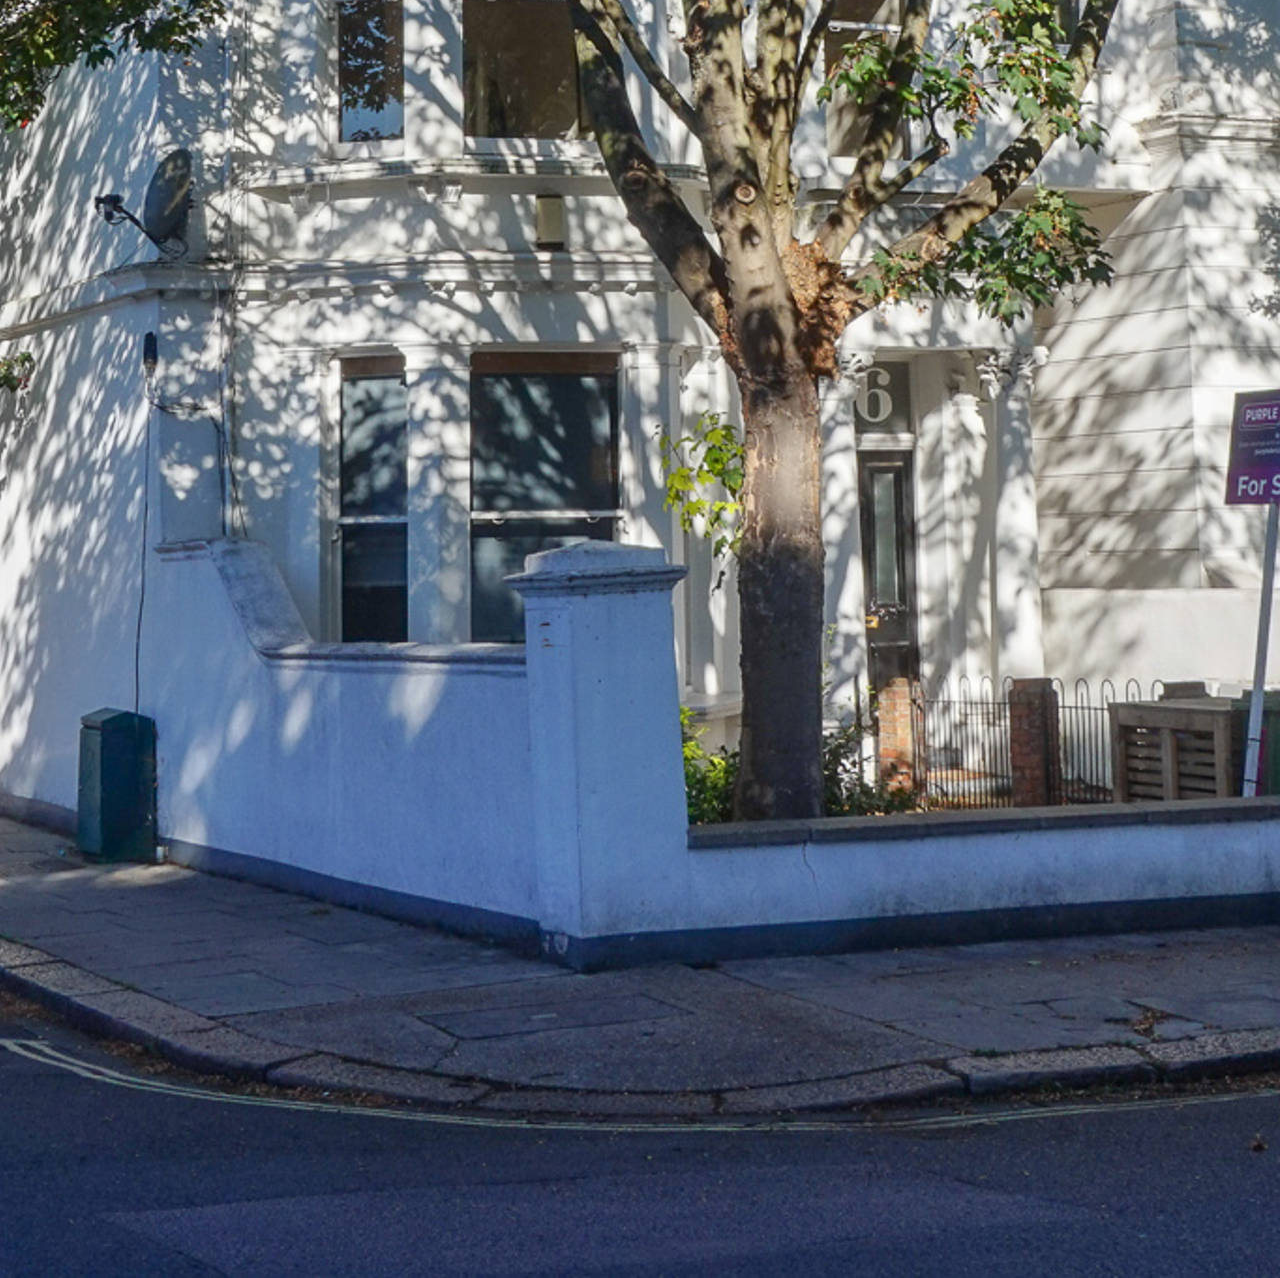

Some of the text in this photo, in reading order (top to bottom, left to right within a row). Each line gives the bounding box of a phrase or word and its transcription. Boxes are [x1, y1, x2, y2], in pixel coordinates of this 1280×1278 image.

[855, 367, 893, 423] 6
[1245, 406, 1279, 422] PURPLE
[1237, 475, 1268, 497] For
